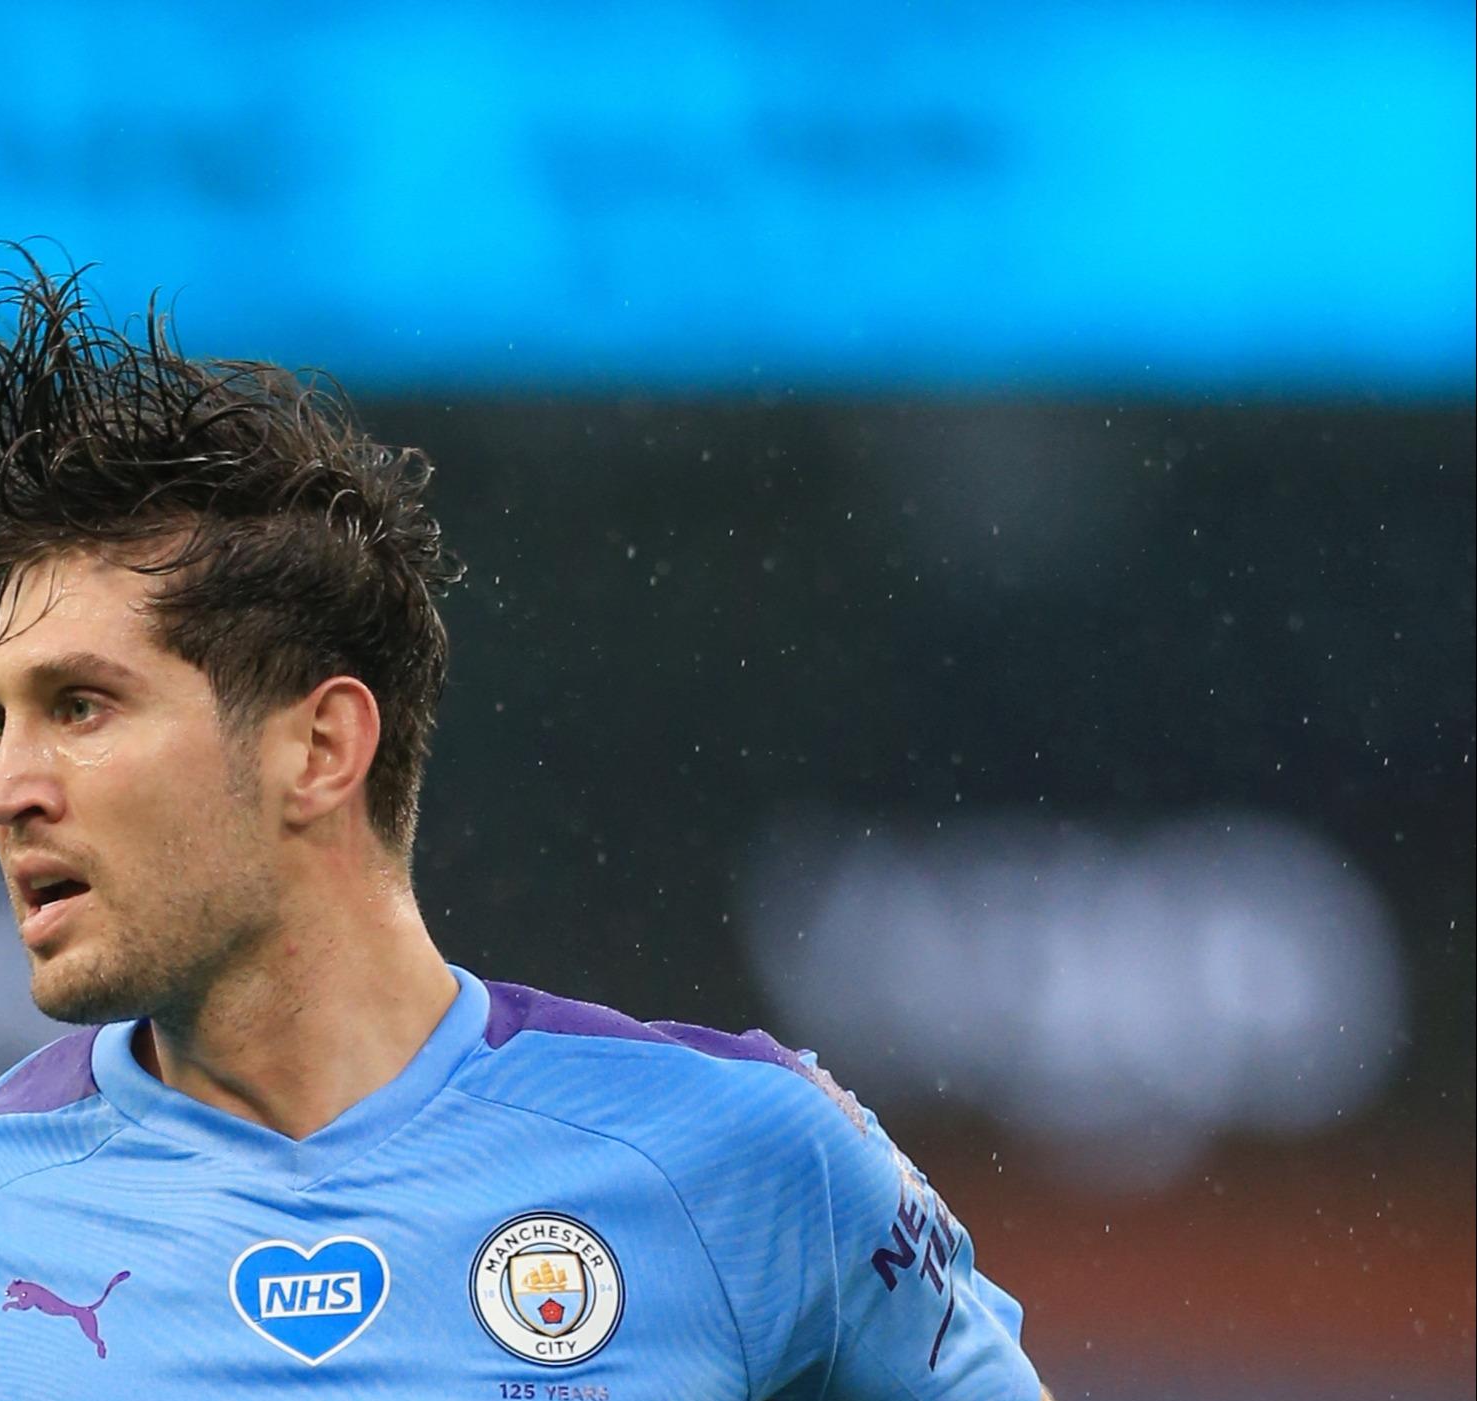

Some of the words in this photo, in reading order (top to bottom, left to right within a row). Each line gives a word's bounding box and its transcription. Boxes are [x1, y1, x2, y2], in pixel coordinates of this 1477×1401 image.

[485, 1224, 604, 1274] MANCHESTER
[265, 1277, 355, 1313] NHS
[534, 1340, 577, 1355] CITY
[499, 1383, 536, 1400] 125
[544, 1385, 610, 1401] YEARS
